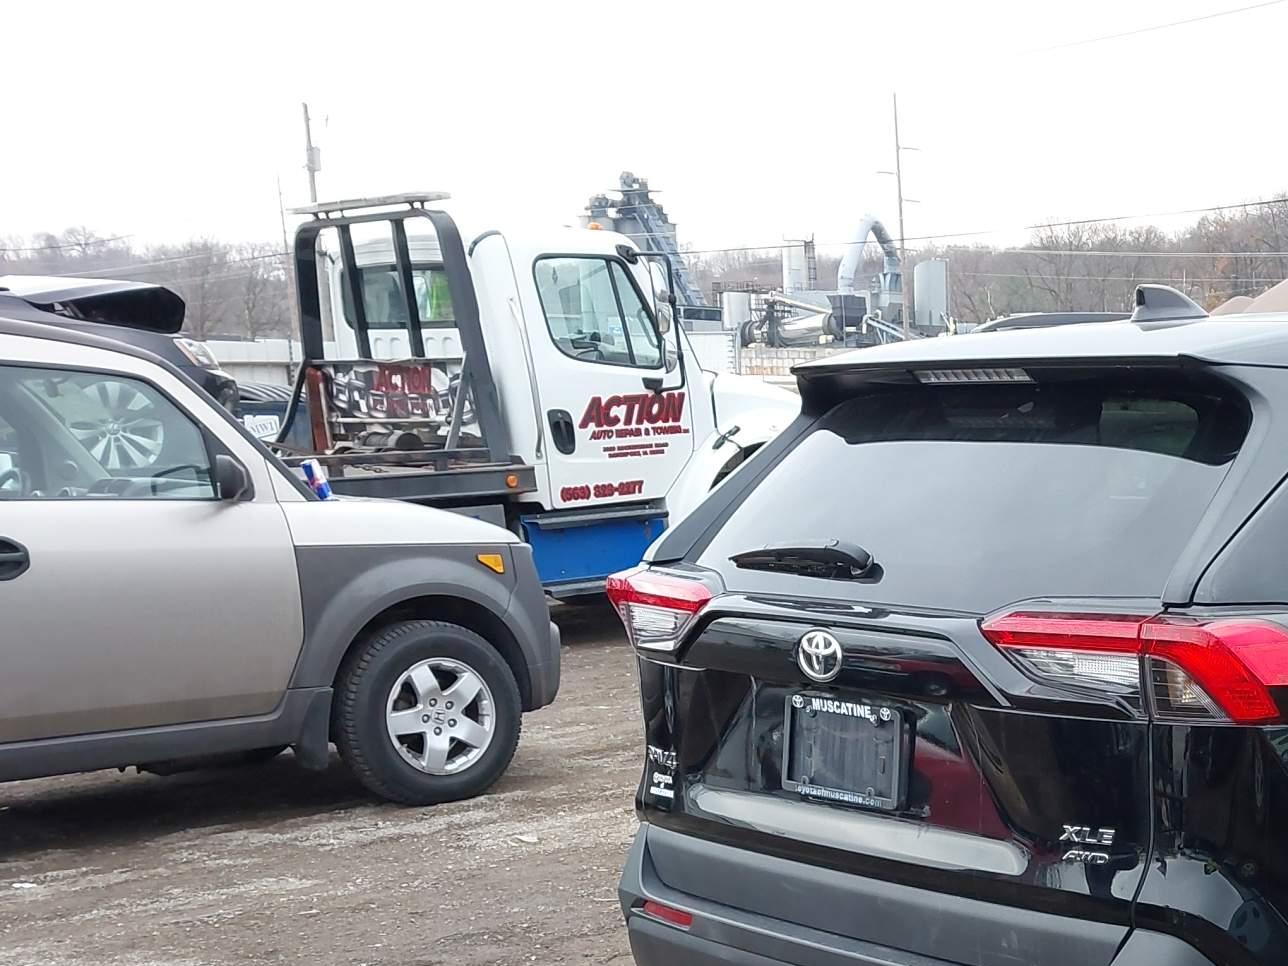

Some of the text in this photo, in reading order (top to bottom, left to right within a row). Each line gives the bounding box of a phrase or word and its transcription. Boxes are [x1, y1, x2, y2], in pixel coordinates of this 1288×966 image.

[579, 392, 685, 429] ACTION
[589, 428, 614, 440] AUTO
[1059, 825, 1116, 845] XLE
